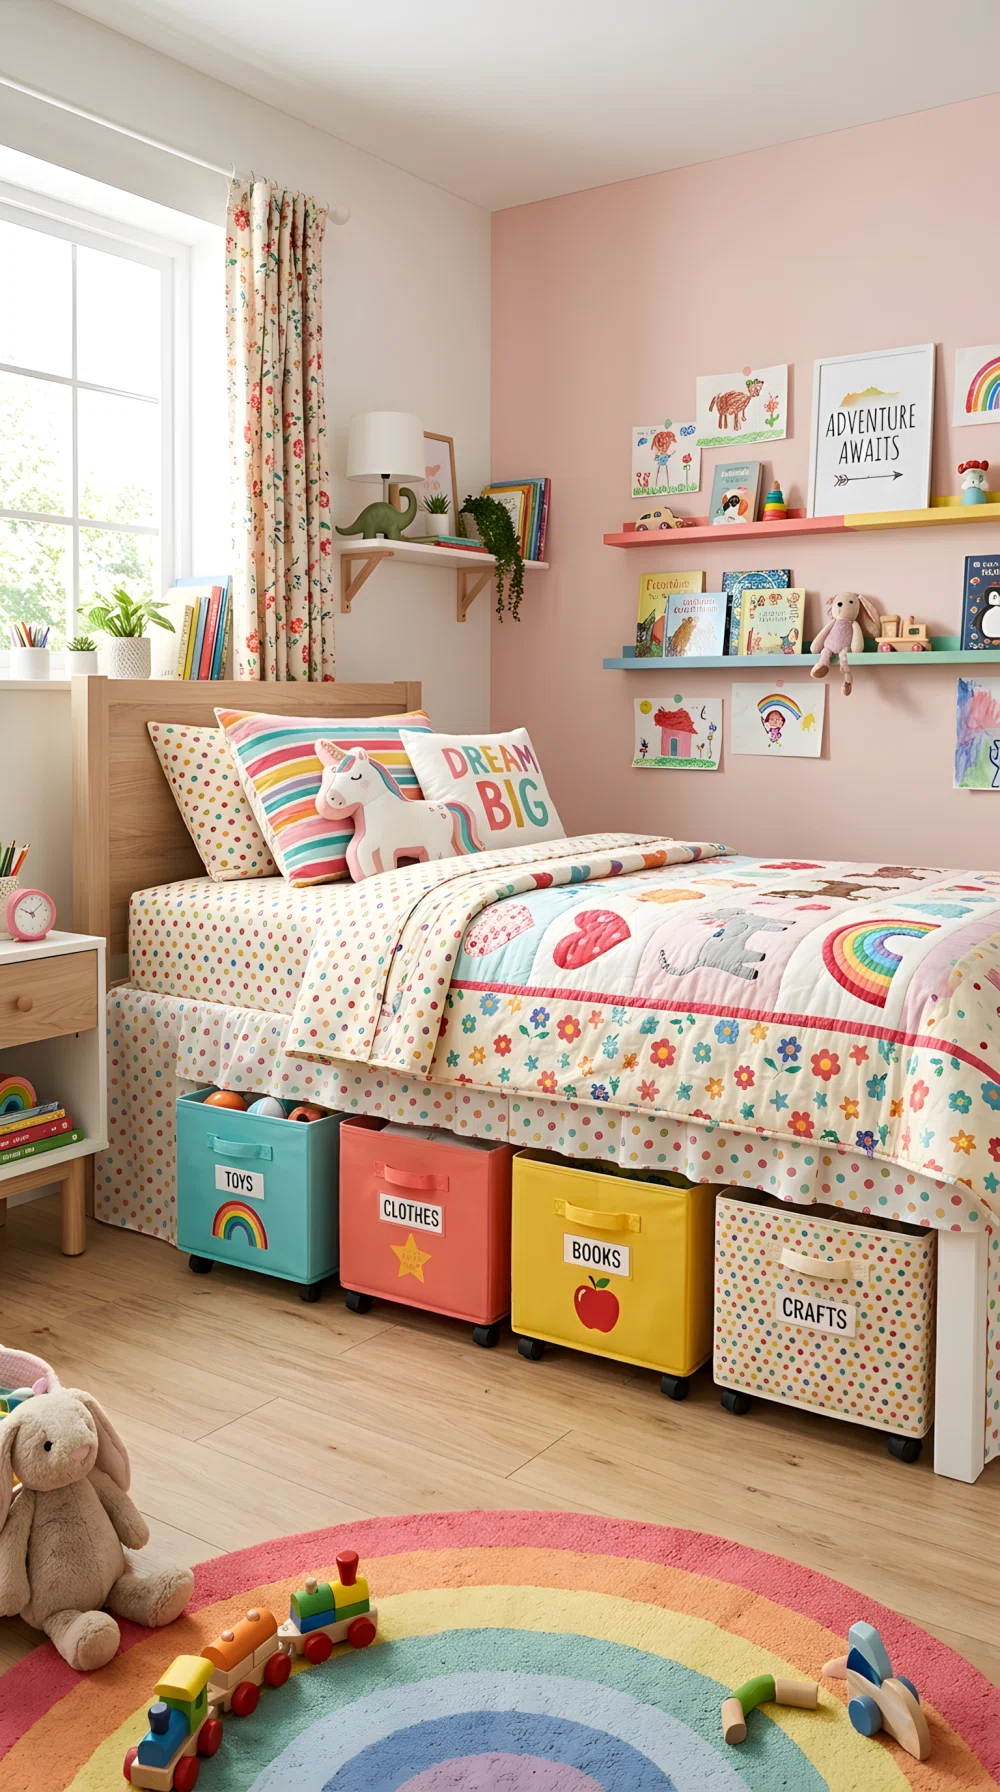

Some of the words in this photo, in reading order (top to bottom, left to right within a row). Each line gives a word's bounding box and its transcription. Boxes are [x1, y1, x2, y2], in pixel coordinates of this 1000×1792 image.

[825, 403, 916, 438] ADVENTURE
[838, 435, 900, 465] AWAITS
[441, 744, 540, 779] DREAM
[475, 778, 549, 831] BIG
[224, 1170, 254, 1192] TOYS
[384, 1199, 439, 1227] CLOTHES
[572, 1241, 621, 1269] BOOKS
[782, 1297, 847, 1329] CRAFTS
